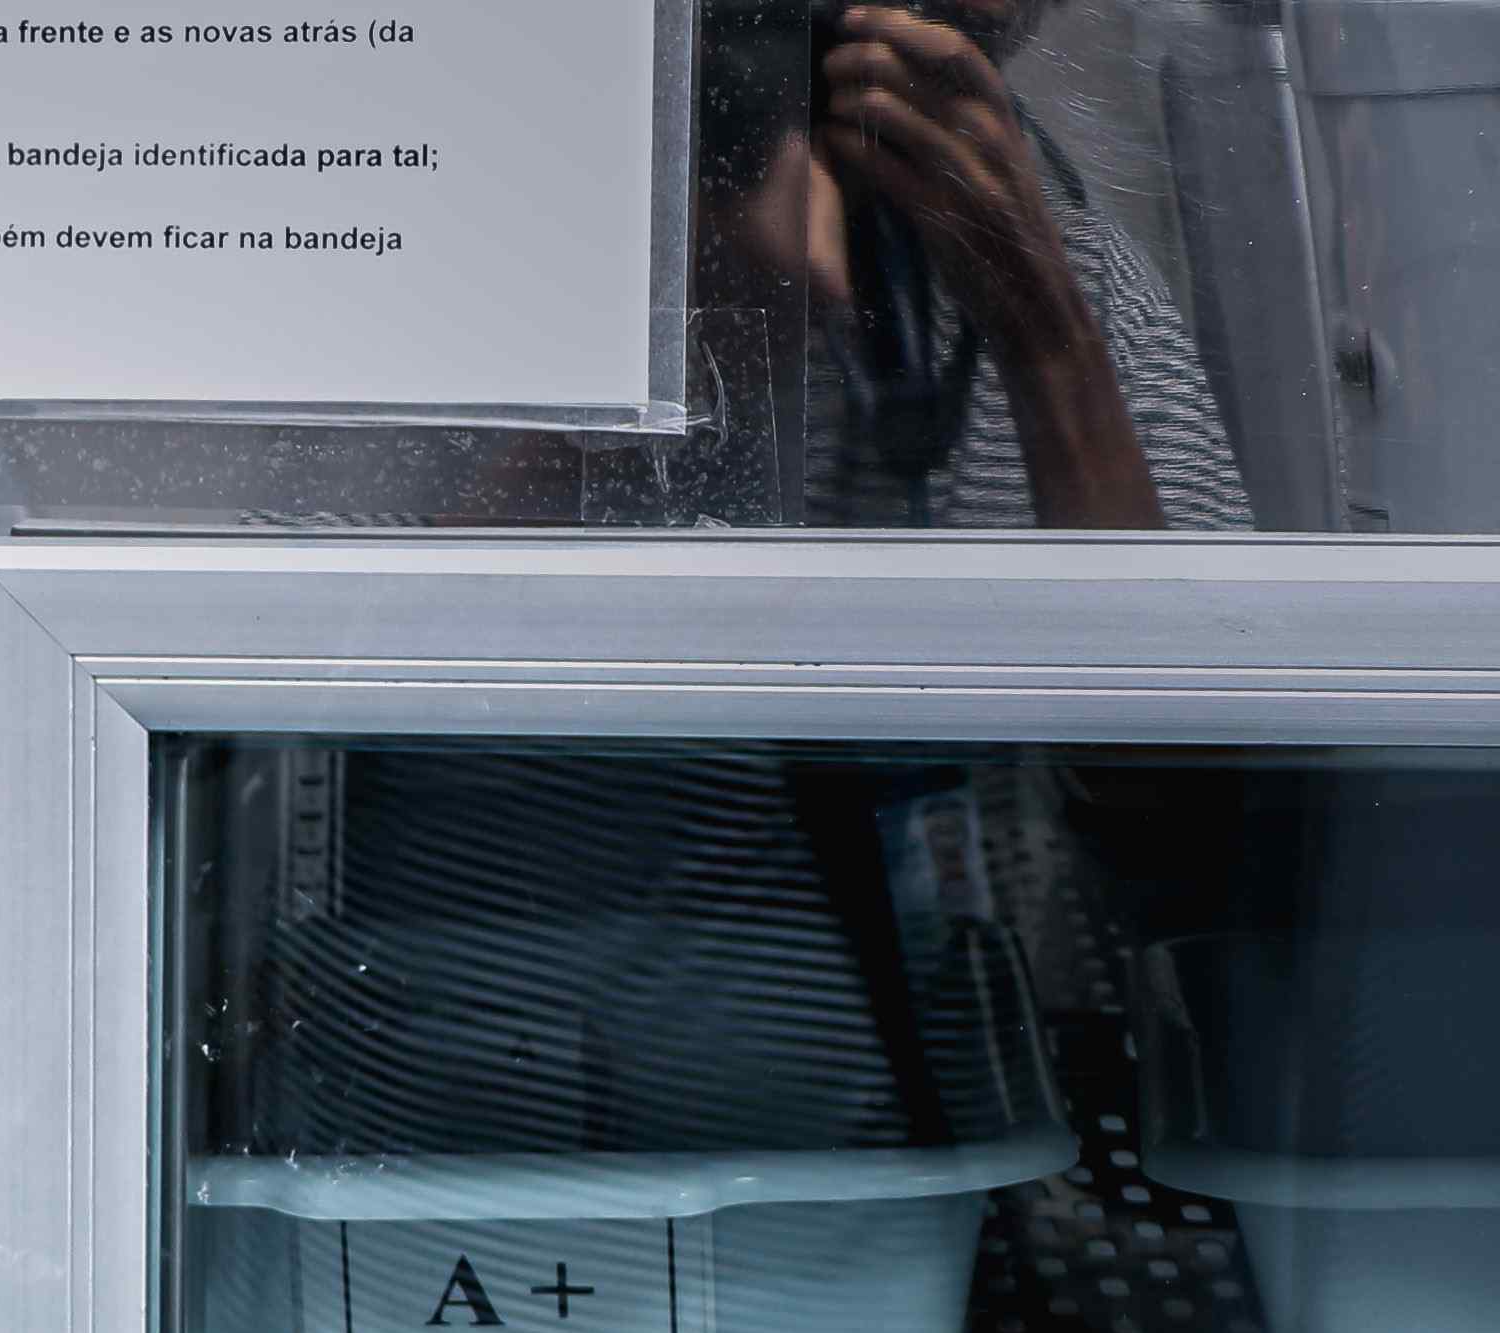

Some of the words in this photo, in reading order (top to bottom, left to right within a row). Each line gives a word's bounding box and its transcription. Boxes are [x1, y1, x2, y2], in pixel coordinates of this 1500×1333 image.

[18, 19, 104, 44] frente
[114, 25, 130, 44] e
[140, 25, 173, 44] as
[184, 25, 273, 43] novas
[283, 19, 357, 43] atrás
[368, 19, 414, 49] (da
[8, 142, 123, 172] bandeja
[134, 143, 306, 167] identificada
[317, 149, 382, 173] para
[392, 143, 438, 172] tal;
[56, 225, 152, 249] devem
[163, 224, 229, 249] ficar
[239, 231, 273, 250] na
[285, 226, 402, 257] bandeja
